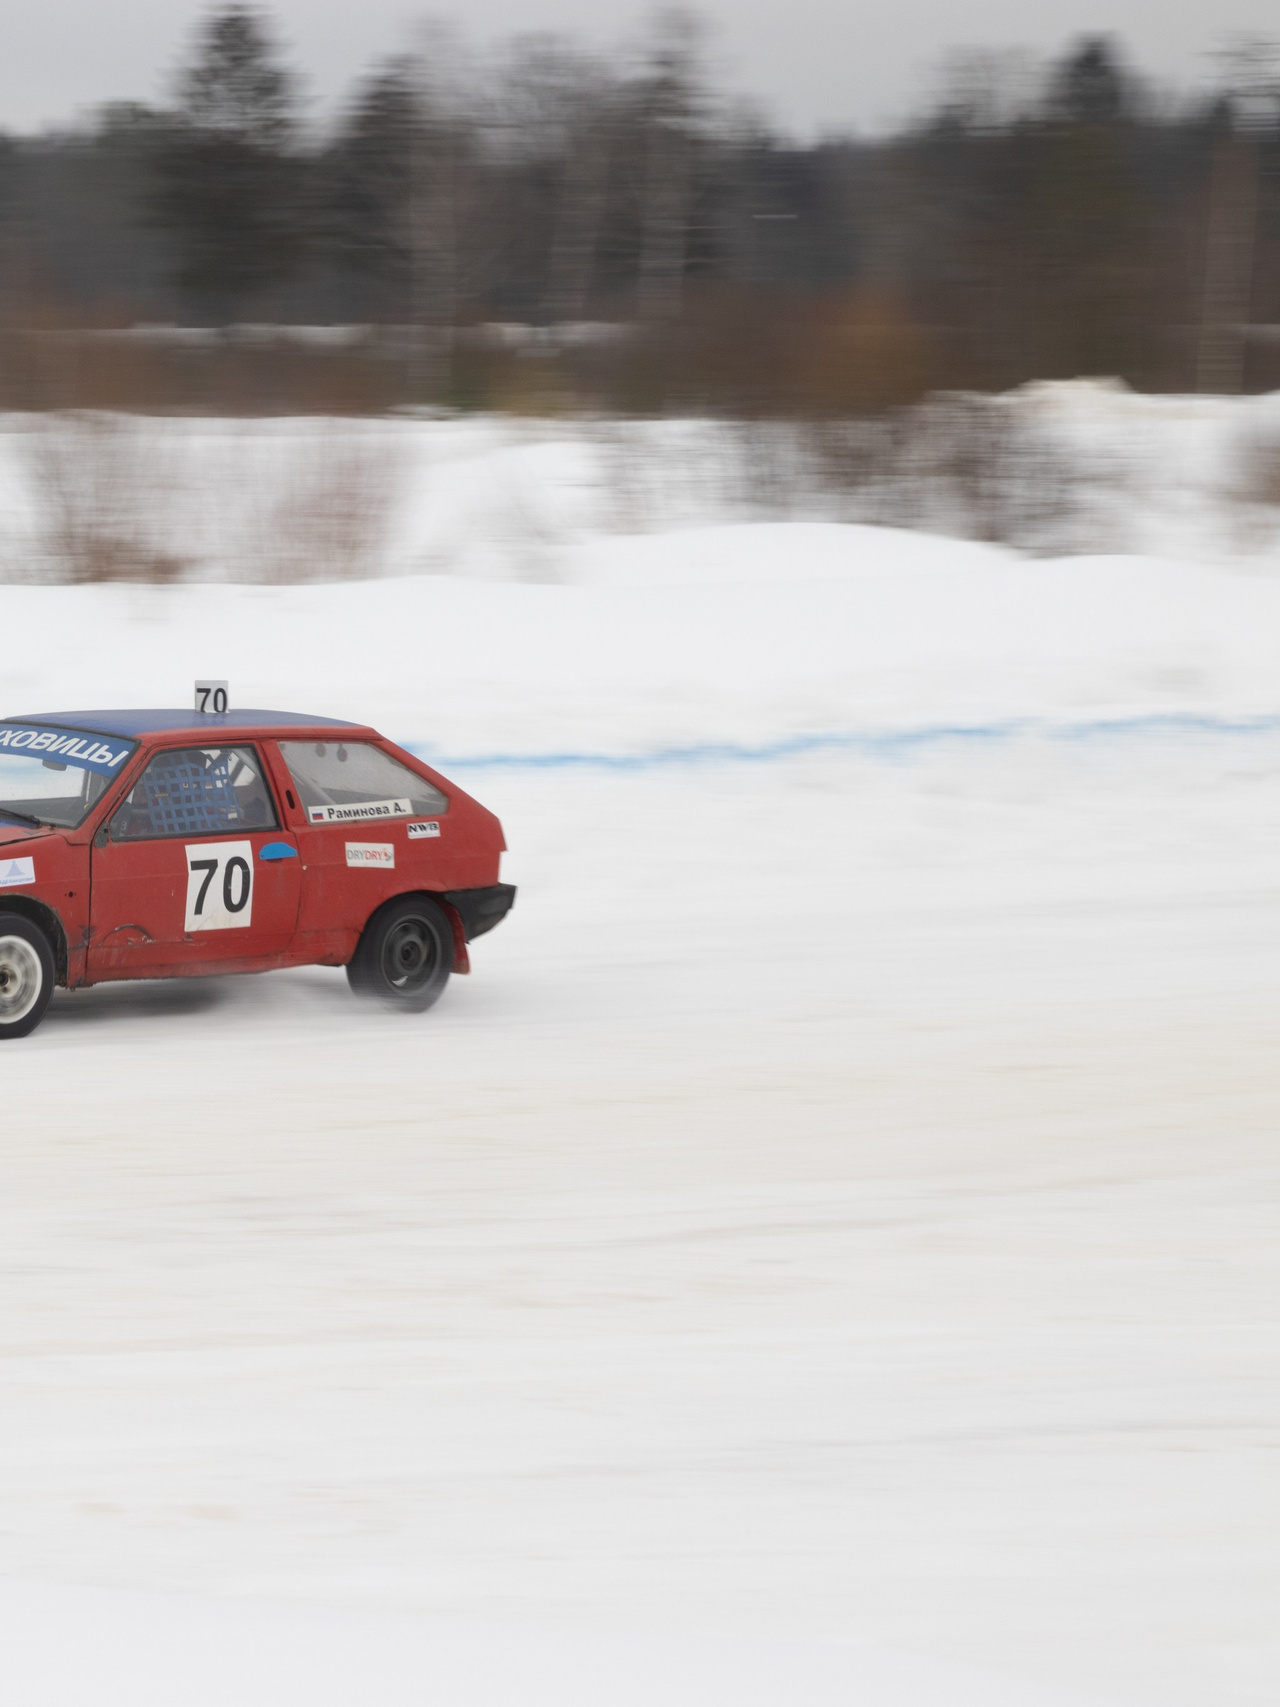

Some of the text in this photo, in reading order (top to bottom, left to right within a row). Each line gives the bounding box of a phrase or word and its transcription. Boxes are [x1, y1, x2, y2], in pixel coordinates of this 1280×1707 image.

[196, 687, 227, 713] 70
[327, 802, 407, 819] Раминова А.
[190, 856, 251, 916] 70
